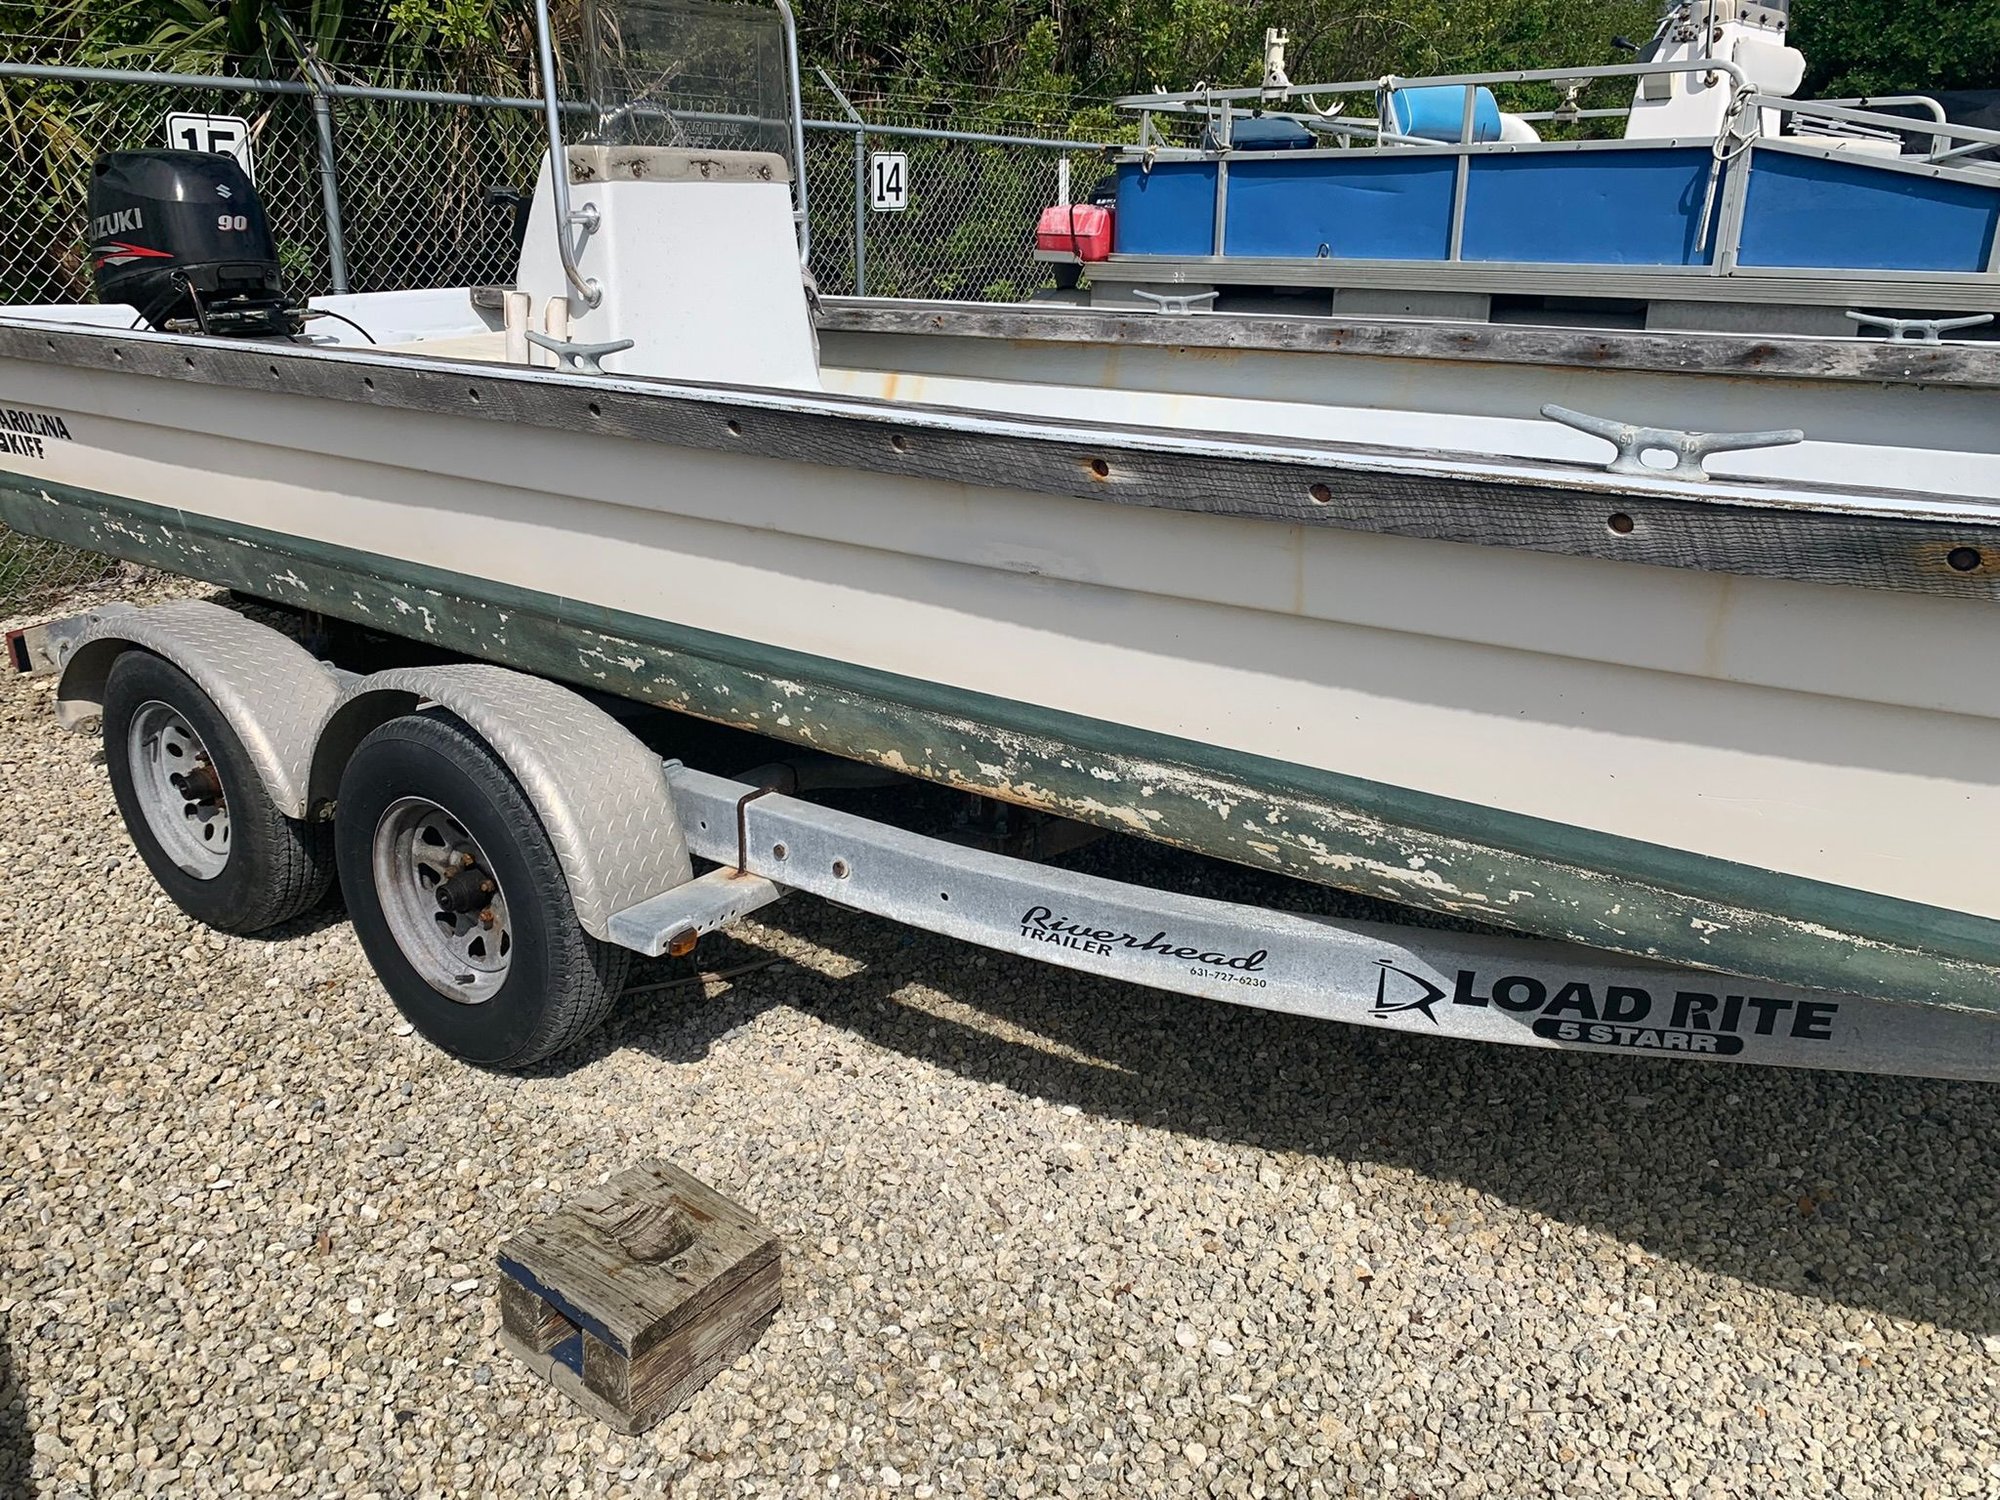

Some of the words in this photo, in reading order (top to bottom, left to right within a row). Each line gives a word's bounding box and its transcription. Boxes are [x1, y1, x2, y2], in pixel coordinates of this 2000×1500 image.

[877, 162, 902, 201] 14
[88, 208, 143, 242] UZUKI
[218, 215, 248, 231] 90
[1021, 906, 1267, 972] Riverhead
[1021, 925, 1113, 957] TRAILER
[1190, 966, 1267, 988] 631-727-6230
[1453, 970, 1652, 1022] LOAD
[1669, 991, 1839, 1040] RITE
[1557, 1023, 1580, 1040] 5
[1588, 1025, 1718, 1053] STARR
